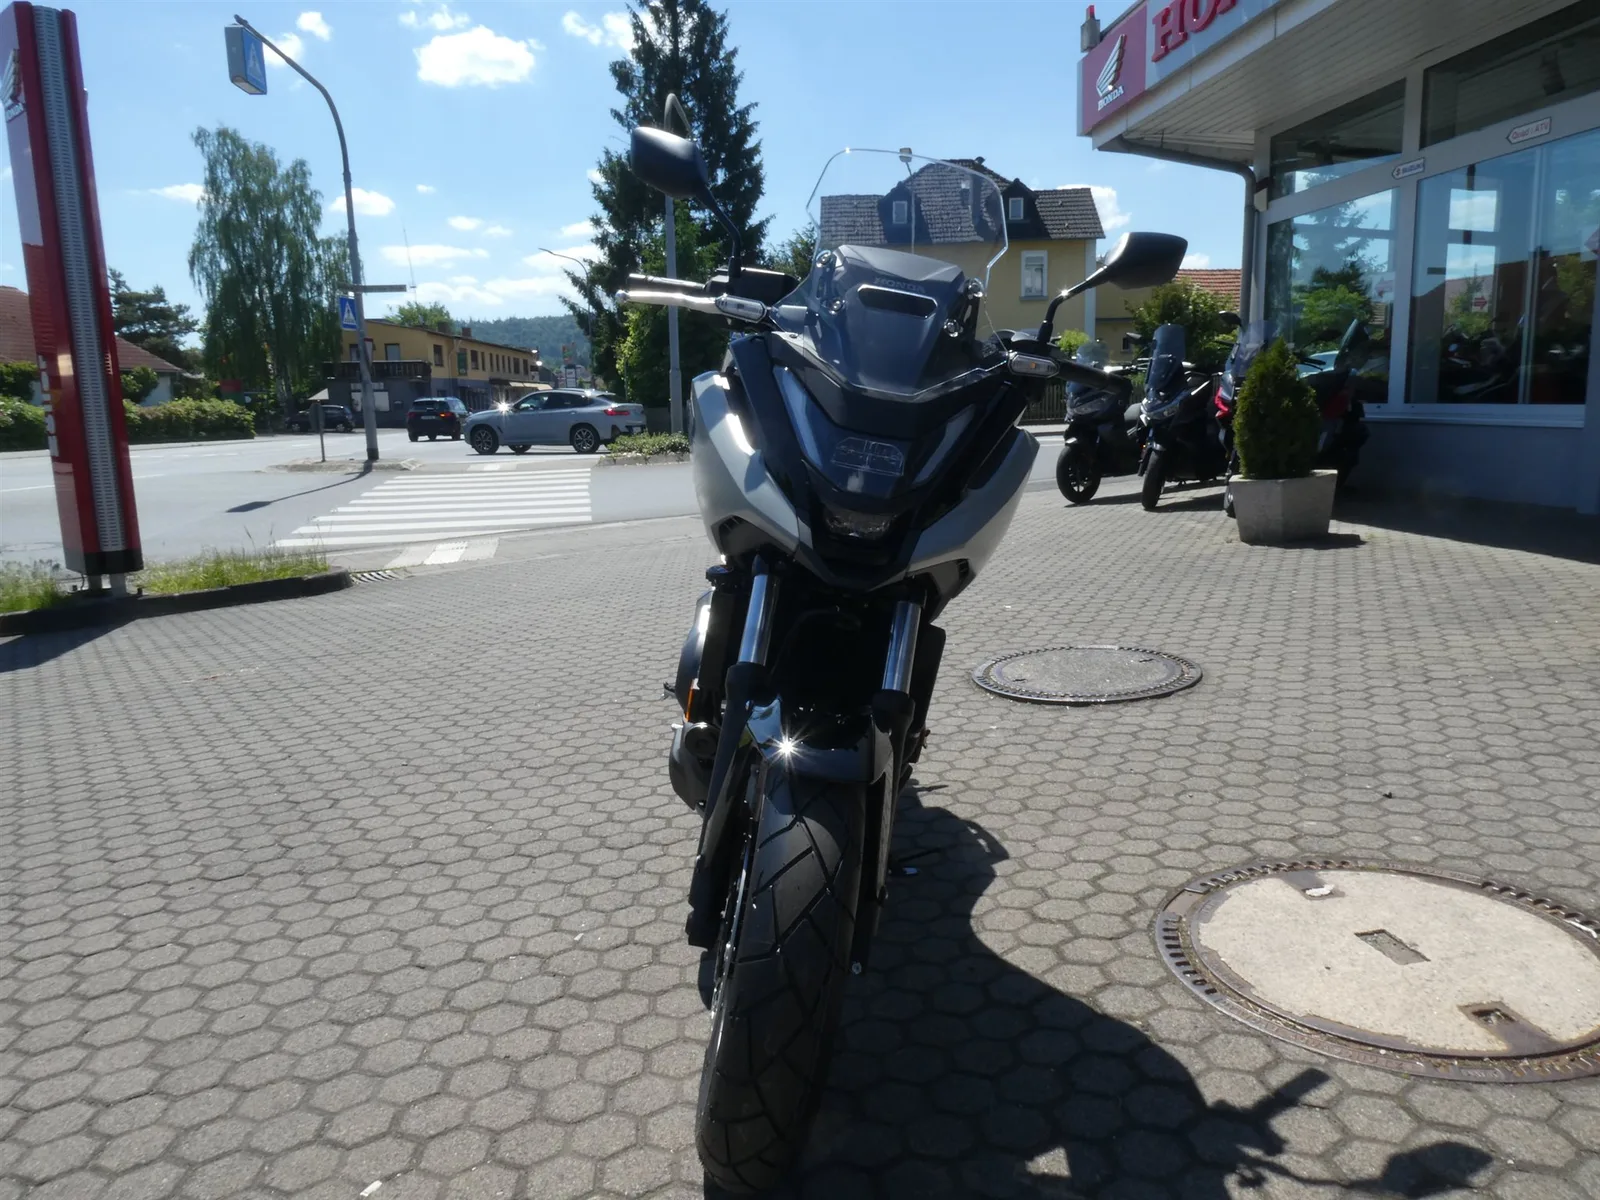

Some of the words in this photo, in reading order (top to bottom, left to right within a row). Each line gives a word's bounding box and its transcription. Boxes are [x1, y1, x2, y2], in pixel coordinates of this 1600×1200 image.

[1152, 0, 1236, 62] HO
[1098, 85, 1124, 111] HONDA
[872, 277, 926, 293] HONDA
